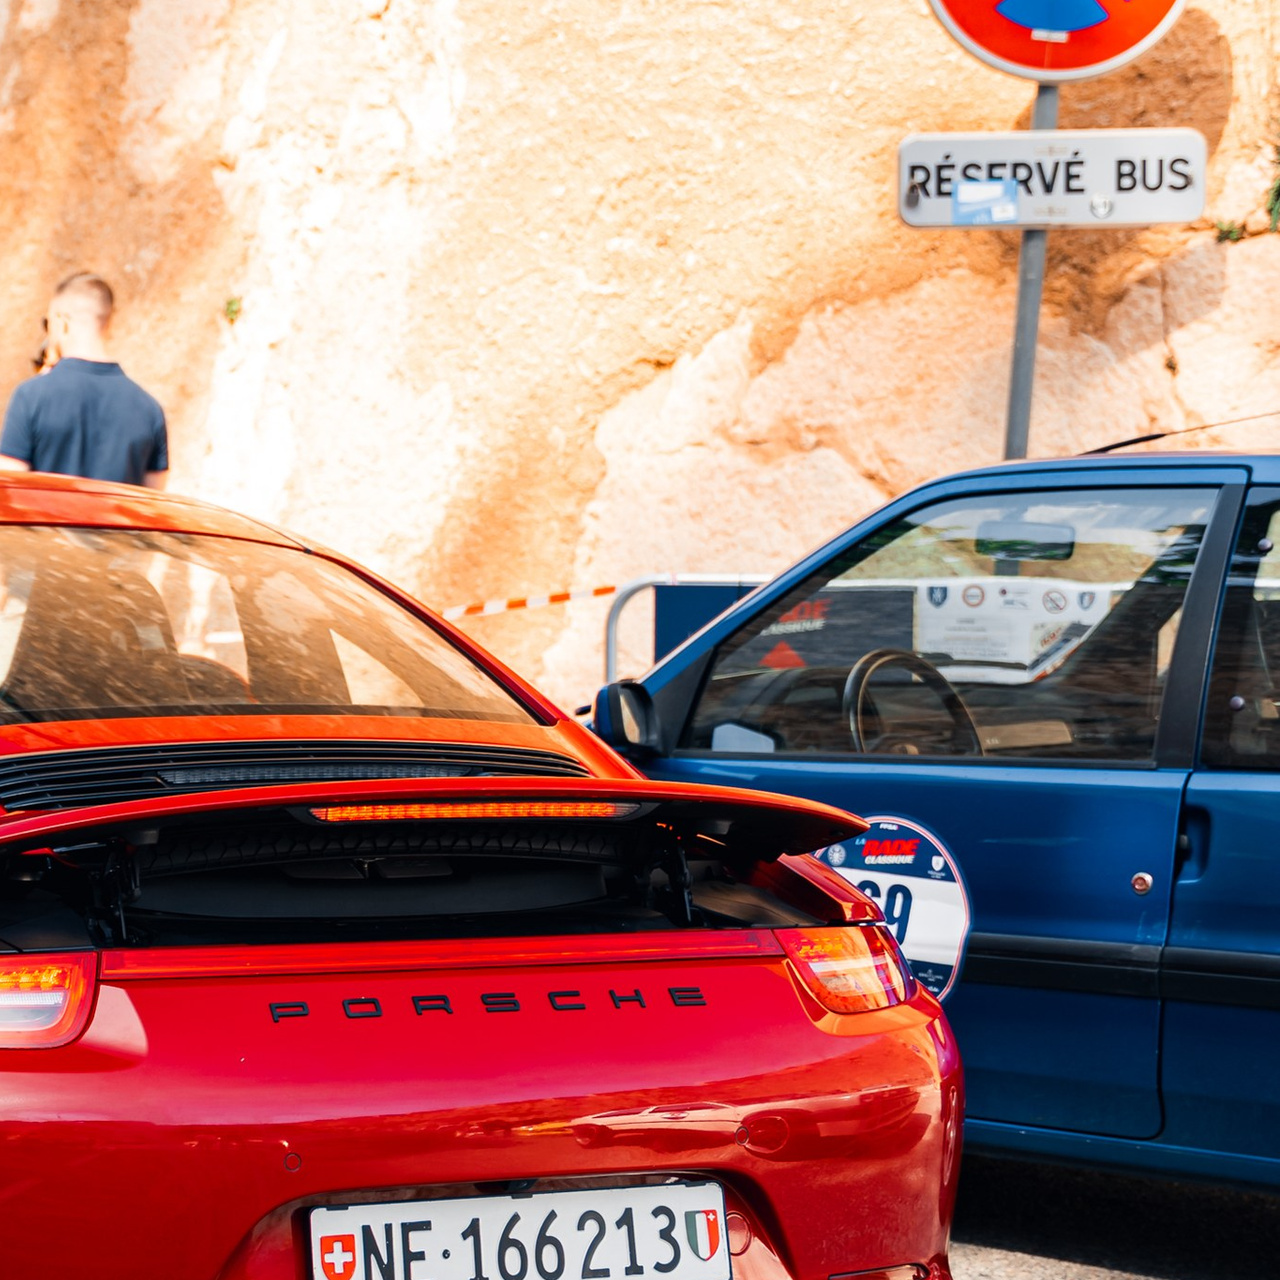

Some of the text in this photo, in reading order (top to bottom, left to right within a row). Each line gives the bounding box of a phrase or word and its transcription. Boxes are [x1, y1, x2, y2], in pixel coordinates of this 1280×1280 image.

[1115, 158, 1192, 192] BUS
[862, 839, 921, 856] RADE
[864, 855, 916, 864] CLASSIQUE
[856, 879, 913, 946] 9
[269, 987, 706, 1023] PORSCHE
